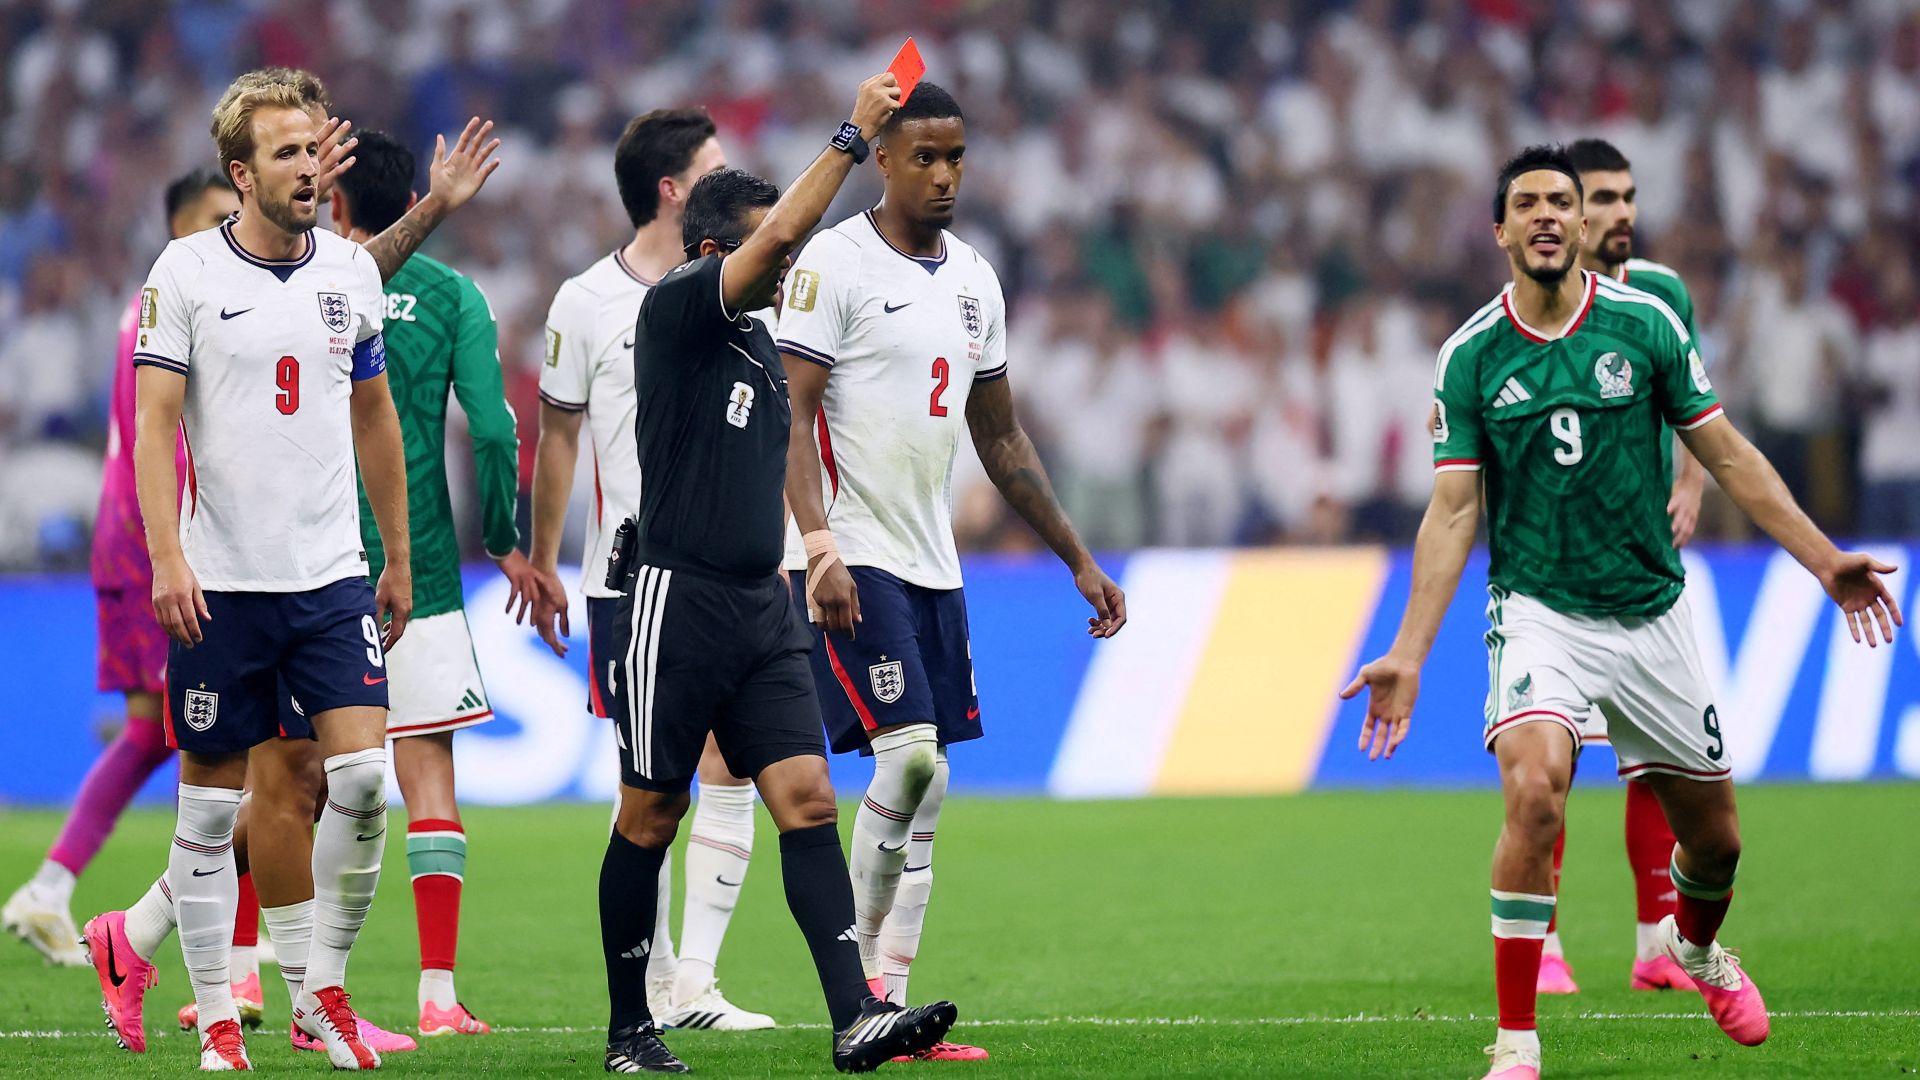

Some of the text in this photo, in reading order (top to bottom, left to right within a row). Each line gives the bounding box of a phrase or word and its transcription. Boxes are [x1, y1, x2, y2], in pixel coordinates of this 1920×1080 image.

[275, 355, 300, 415] 9
[929, 357, 949, 417] 2
[1550, 407, 1583, 466] 9
[361, 614, 383, 668] 9
[1703, 704, 1723, 761] 9
